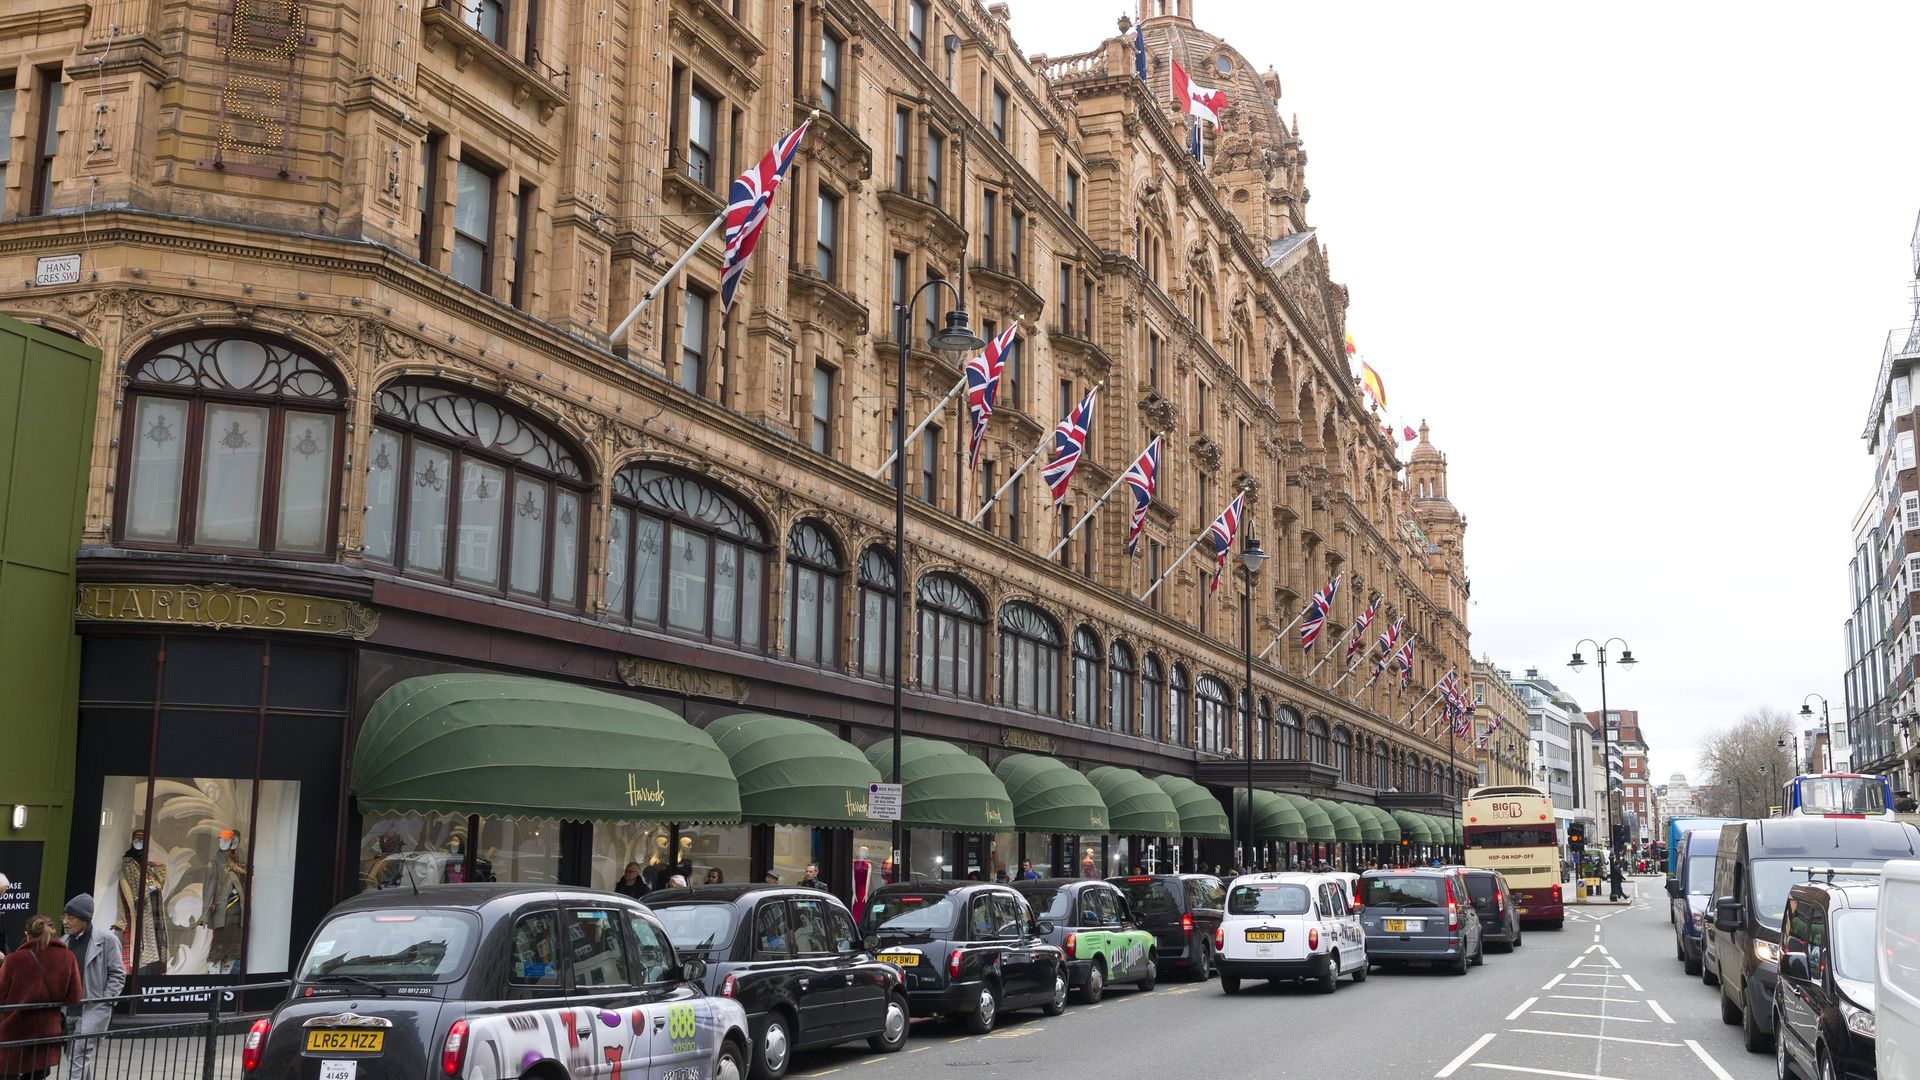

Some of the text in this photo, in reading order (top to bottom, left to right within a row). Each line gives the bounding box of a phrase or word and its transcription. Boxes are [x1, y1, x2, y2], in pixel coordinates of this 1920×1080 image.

[46, 262, 71, 272] HANS
[87, 588, 287, 626] HARRODS
[625, 773, 665, 807] Harrods
[1492, 803, 1508, 811] BIG
[1493, 811, 1510, 819] BUS
[900, 956, 915, 964] BWU
[668, 1004, 696, 1040] 888
[313, 1034, 378, 1048] LR62 HZZ
[672, 1041, 696, 1054] casino
[326, 1072, 349, 1080] 41459
